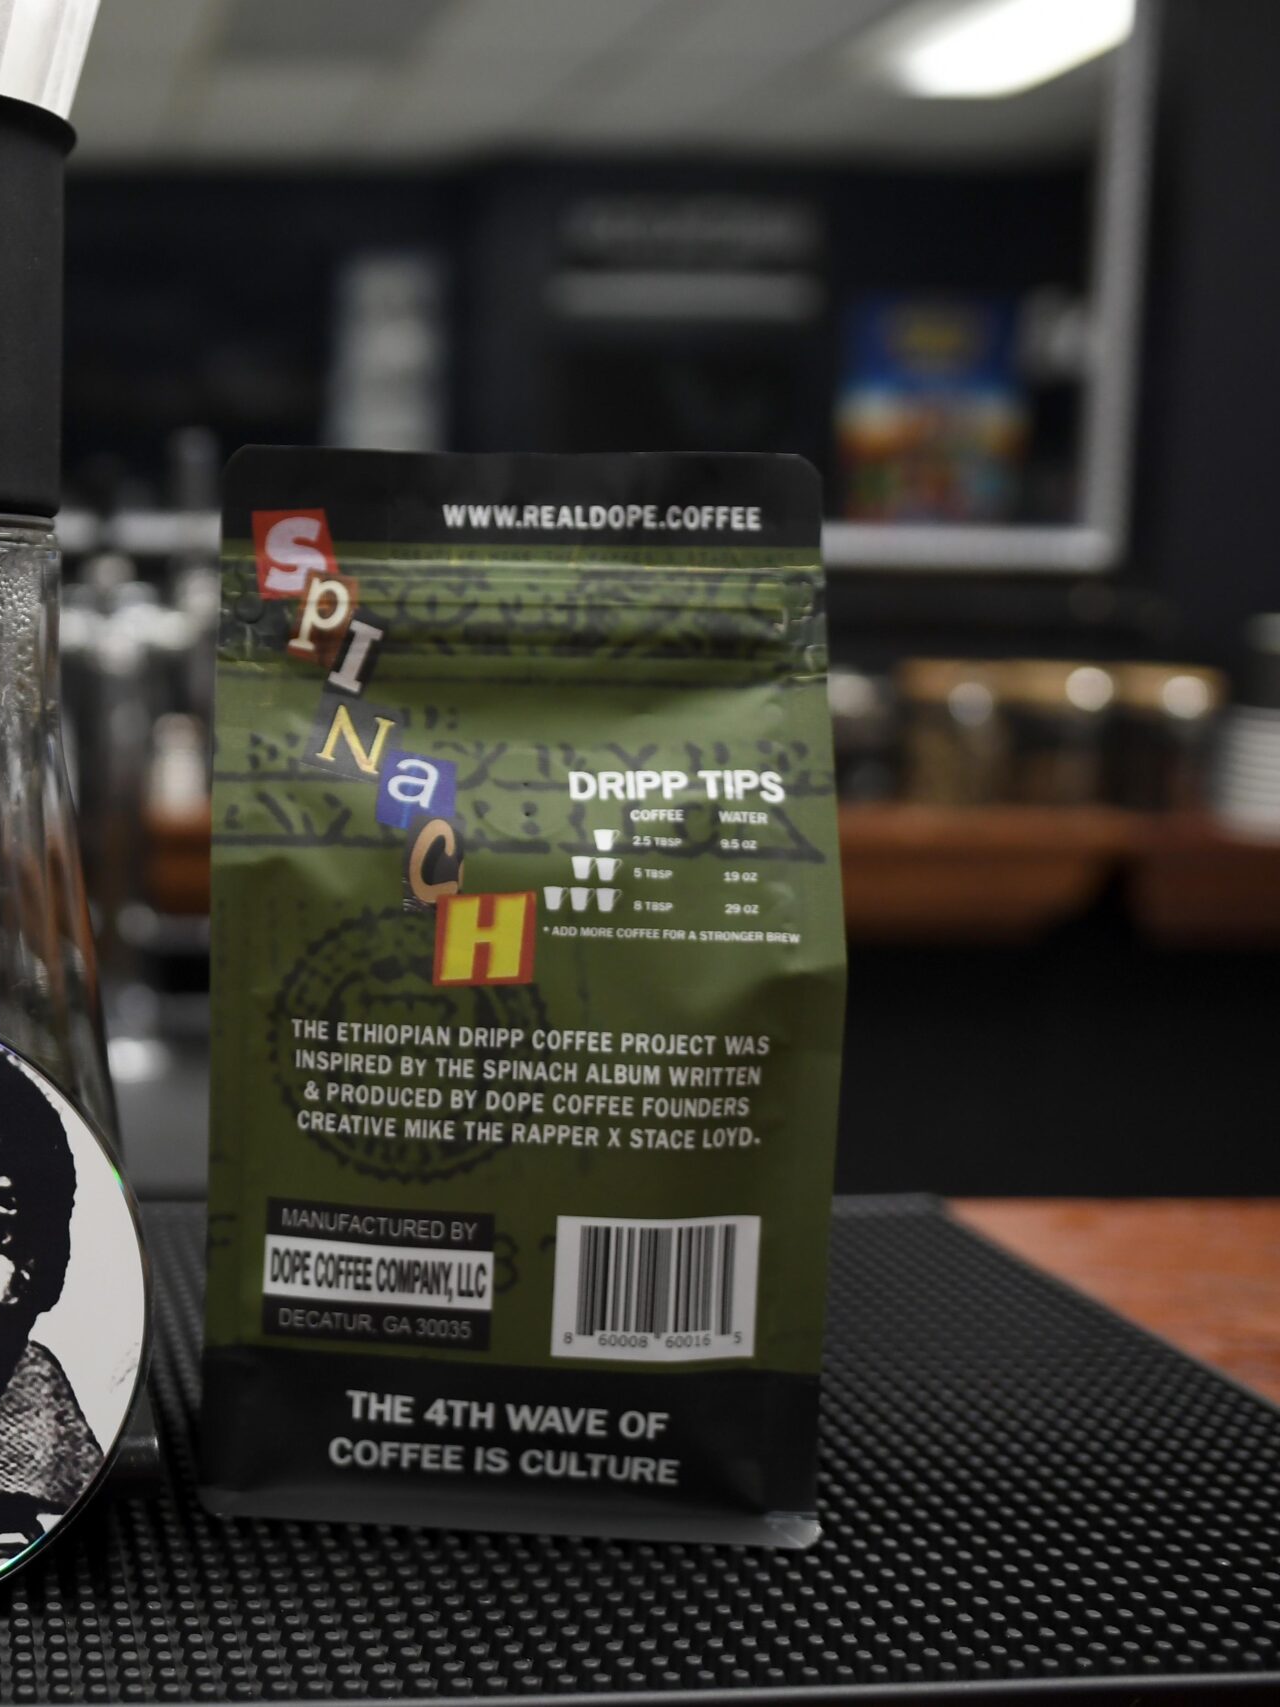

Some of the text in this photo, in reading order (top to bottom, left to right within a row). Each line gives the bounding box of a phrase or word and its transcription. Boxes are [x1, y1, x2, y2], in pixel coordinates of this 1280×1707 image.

[443, 504, 762, 531] WWW.REALDOPE.COFFEE
[569, 769, 785, 803] DRIPP TIPS
[630, 809, 768, 824] COFFEE WATER
[632, 836, 653, 847] 2.5
[654, 836, 683, 848] TBSP
[741, 839, 759, 850] OZ
[633, 867, 759, 883] 5 TBSP 19 OZ
[643, 901, 673, 912] TBSP
[724, 903, 741, 915] 29
[742, 904, 760, 915] OZ
[551, 926, 577, 937] ADD
[579, 926, 613, 938] MORE
[615, 927, 660, 939] COFFEE
[662, 928, 686, 940] FOR
[687, 930, 697, 940] A
[699, 930, 764, 943] STRONGER
[765, 931, 802, 944] BREW
[291, 1018, 770, 1056] THE ETHIOPIAN DRIPP COFFEE PROJECT WAS
[295, 1049, 761, 1087] INSPIRED BY THE SPINACH ALBUM WRITTEN
[303, 1081, 750, 1118] & PRODUCED BY DOPE COFFEE FOUNDERS
[297, 1110, 761, 1150] CREATIVE MIKE THE RAPPER X STACE LOYD.
[281, 1207, 478, 1243] MANUFACTURED BY
[270, 1247, 311, 1286] DOPE
[314, 1251, 373, 1293] COFFEE
[375, 1256, 454, 1303] COMPANY,
[455, 1263, 487, 1299] LLC
[383, 1315, 413, 1337] GA
[416, 1316, 472, 1341] 30035
[564, 1332, 742, 1350] 8 60008 60016 5
[346, 1389, 669, 1440] THE 4TH WAVE OF
[328, 1436, 681, 1486] COFFEE IS CULTURE
